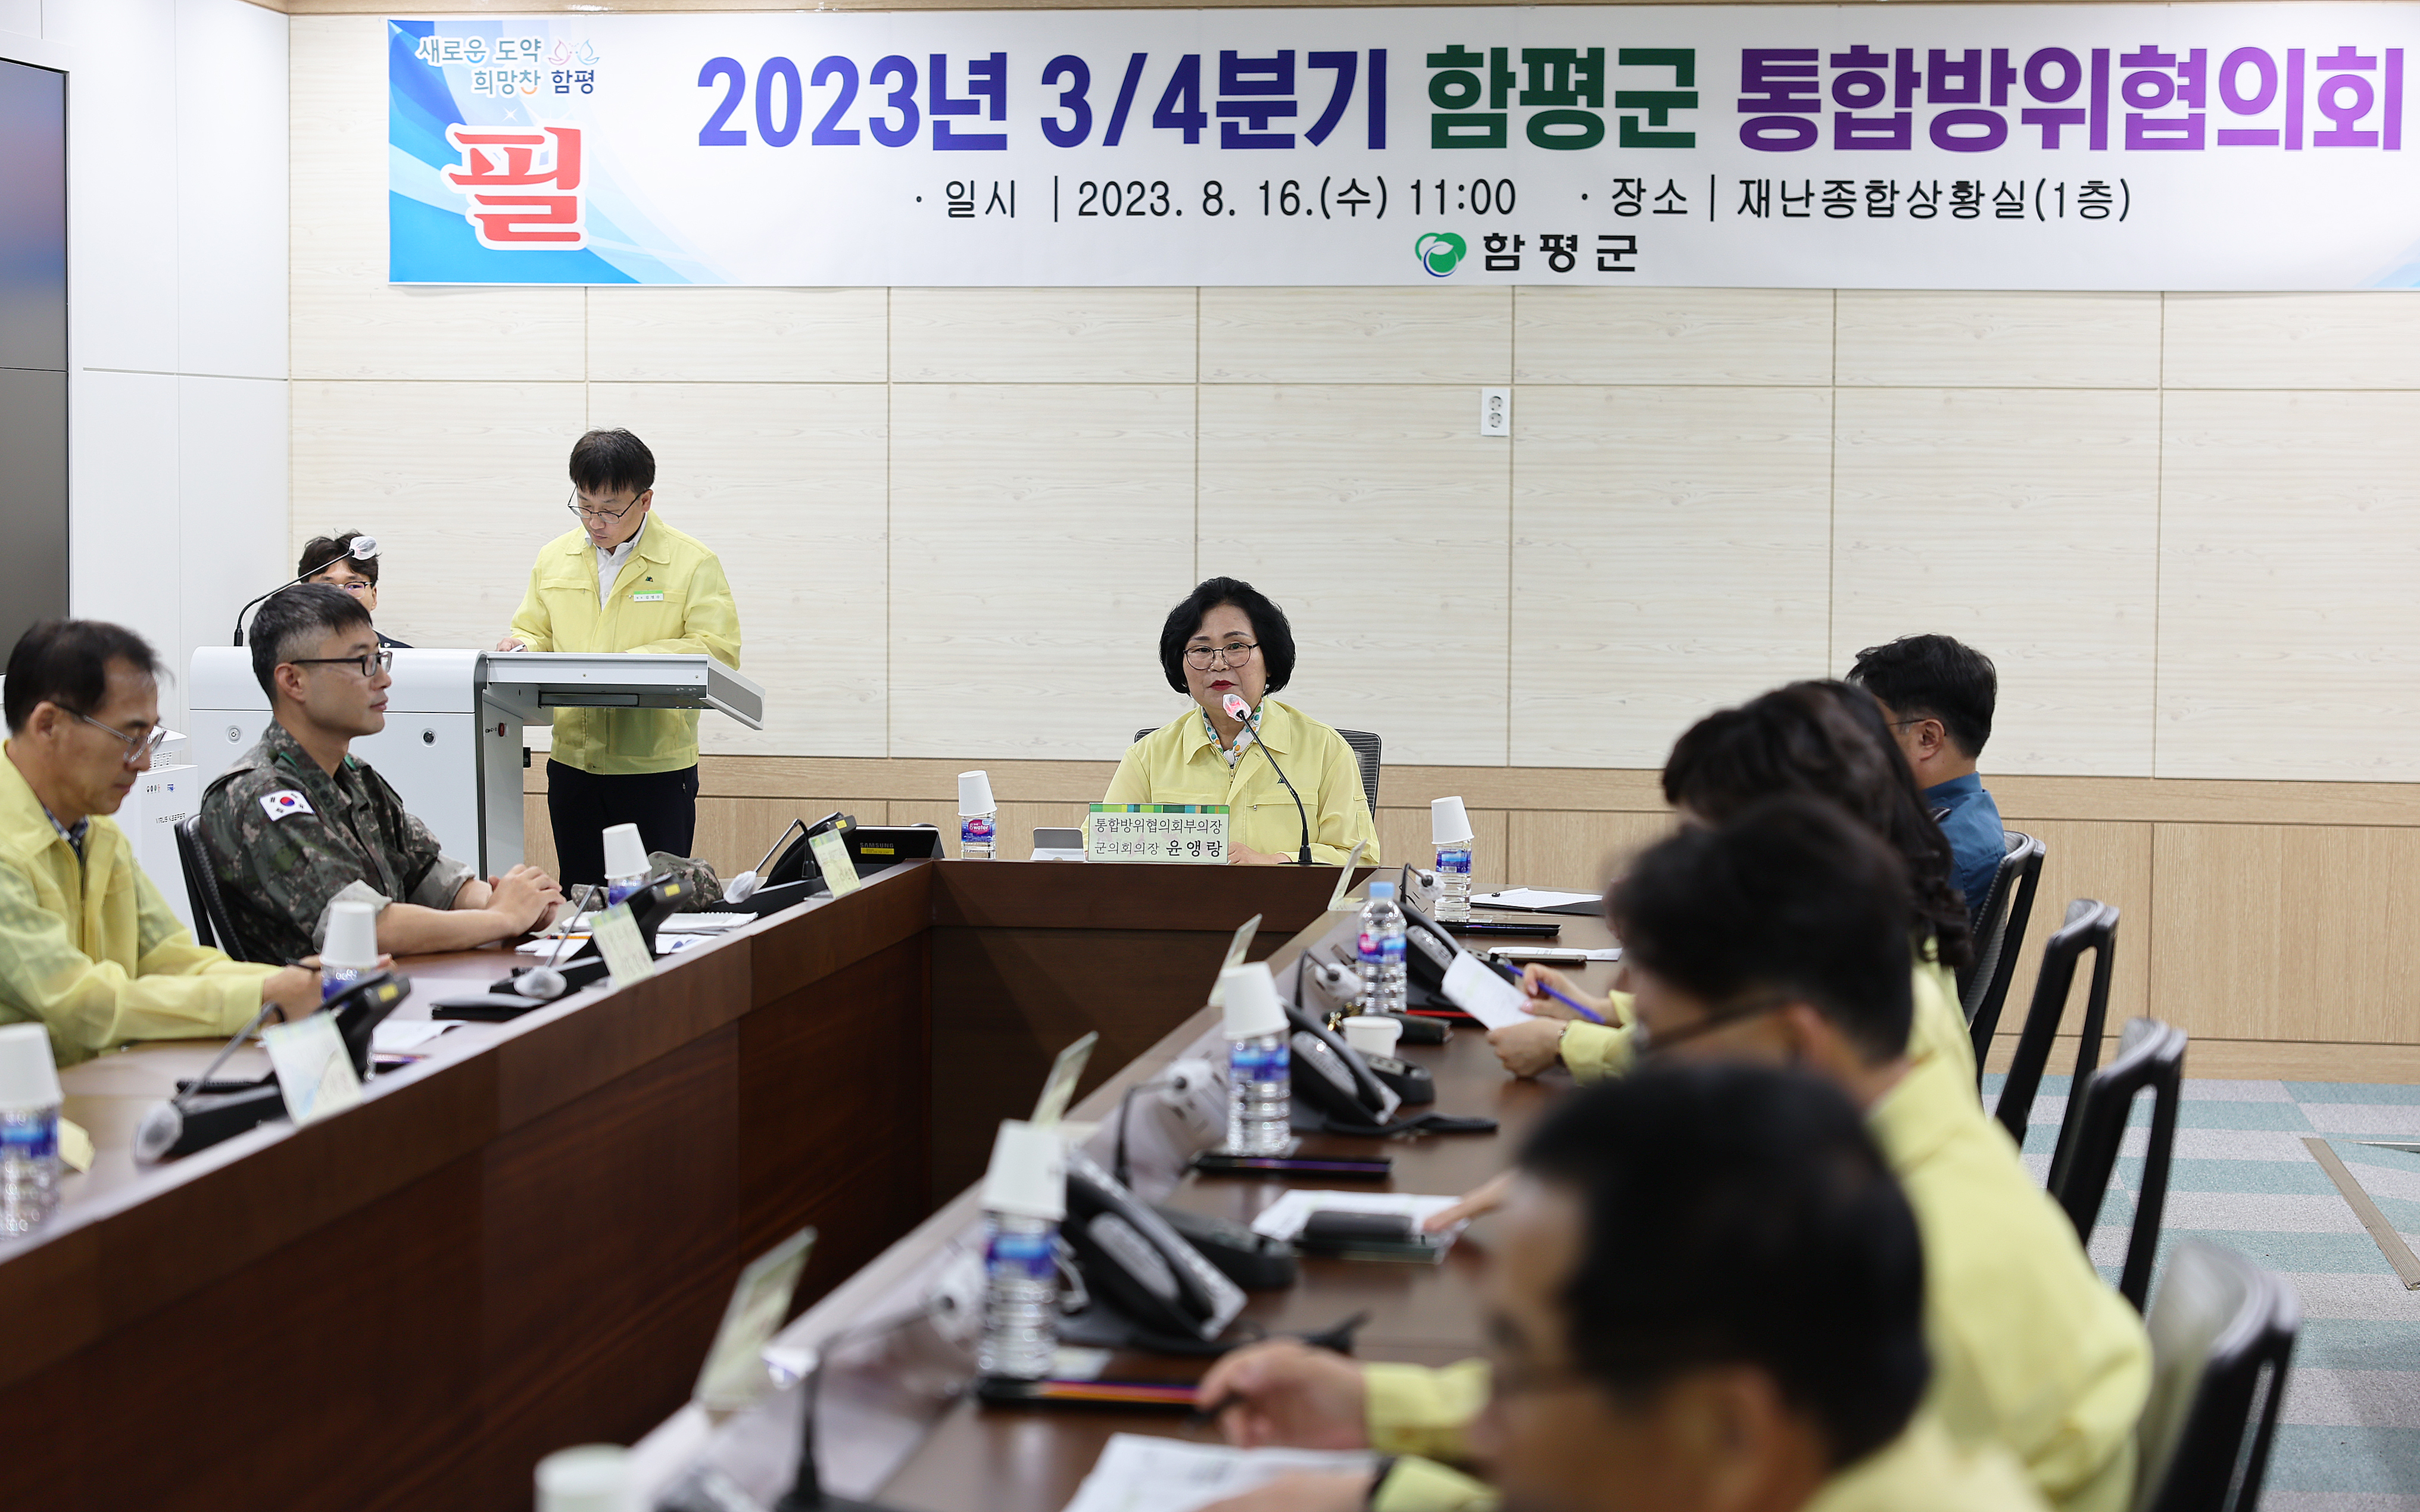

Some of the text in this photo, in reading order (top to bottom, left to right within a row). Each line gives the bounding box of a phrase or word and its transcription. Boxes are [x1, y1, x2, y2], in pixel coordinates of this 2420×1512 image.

[419, 38, 541, 64] 새로운 도약
[474, 69, 595, 95] 희망찬 함평
[698, 44, 2405, 154] 2023년 3/4분기 함평군 통합방위협의회
[448, 126, 581, 242] 필
[946, 176, 1517, 221] 일시 2023. 8. 16.(수) 11:00
[1611, 178, 2132, 223] 장소 재난종합상황실(1층)
[1094, 818, 1223, 835] 통합방위협의회부의장
[1094, 842, 1159, 855] 군의회의장
